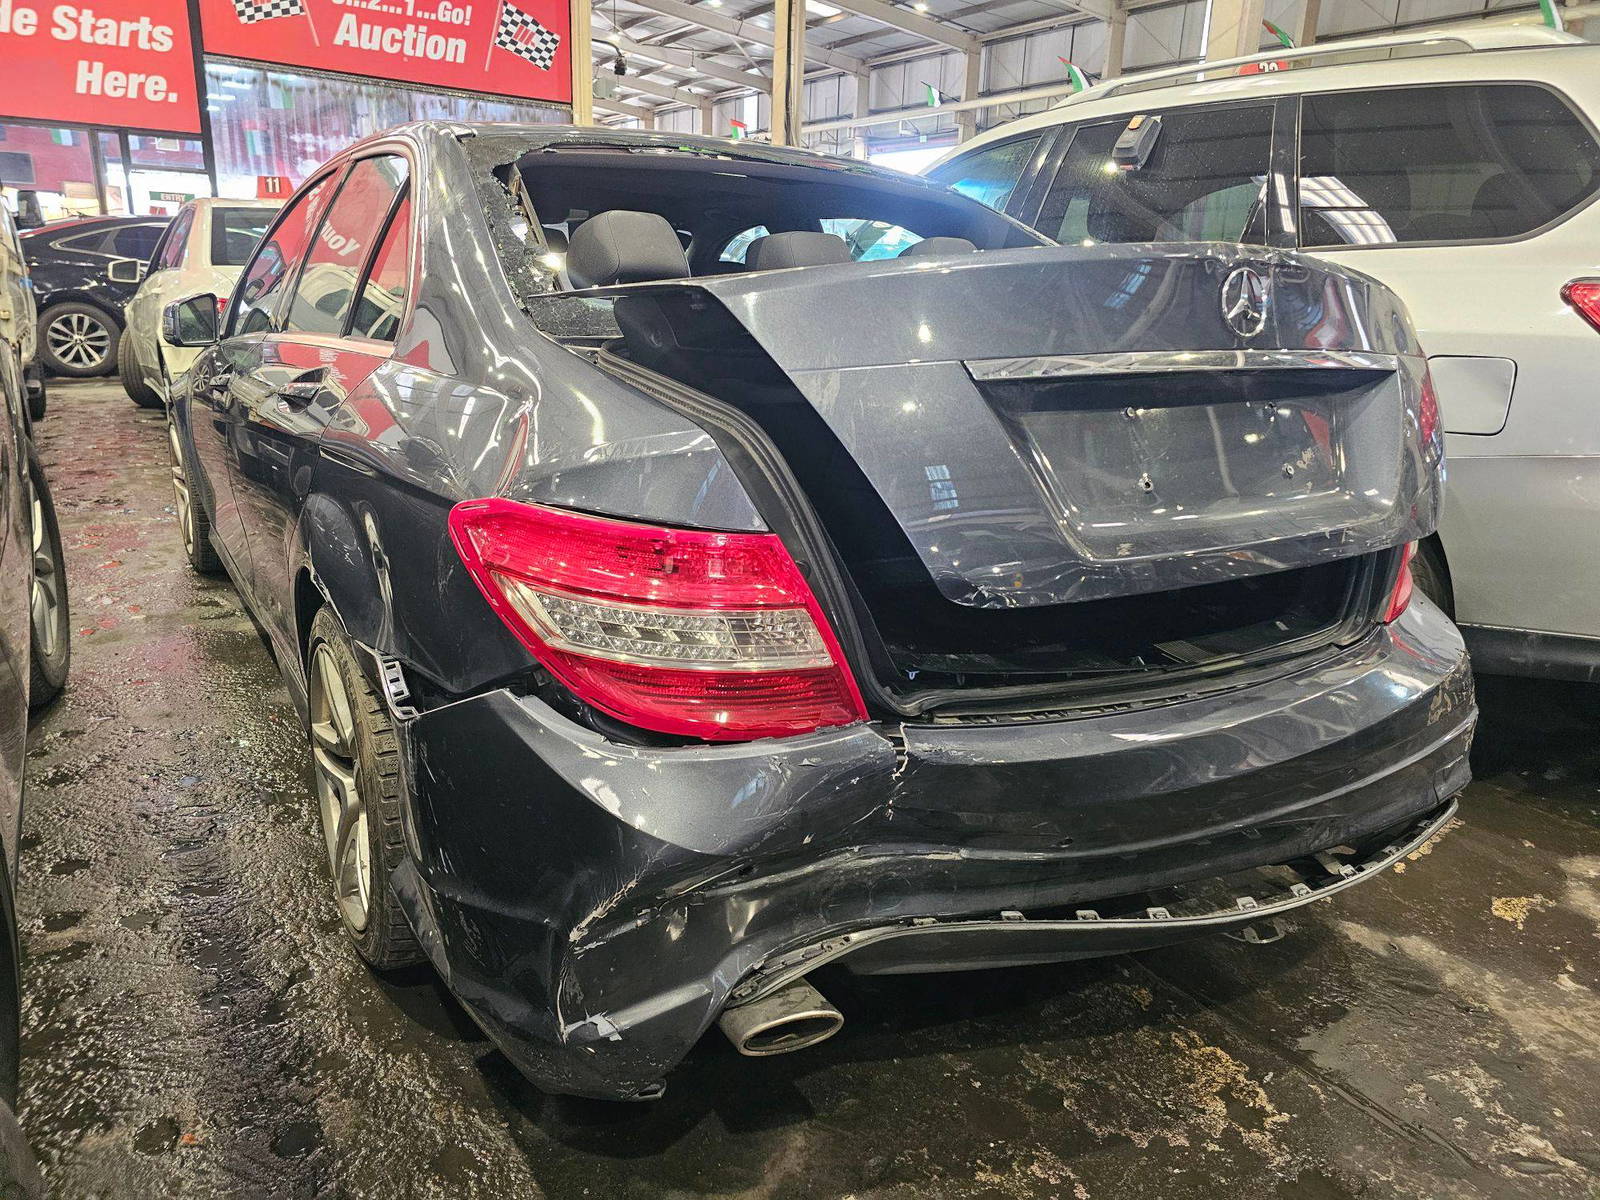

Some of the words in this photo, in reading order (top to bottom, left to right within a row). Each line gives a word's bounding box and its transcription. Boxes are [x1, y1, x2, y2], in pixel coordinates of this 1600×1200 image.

[51, 5, 174, 52] Starts
[333, 13, 467, 63] Auction
[75, 60, 178, 103] Here.
[160, 192, 186, 202] ENTRY
[266, 177, 281, 193] 11
